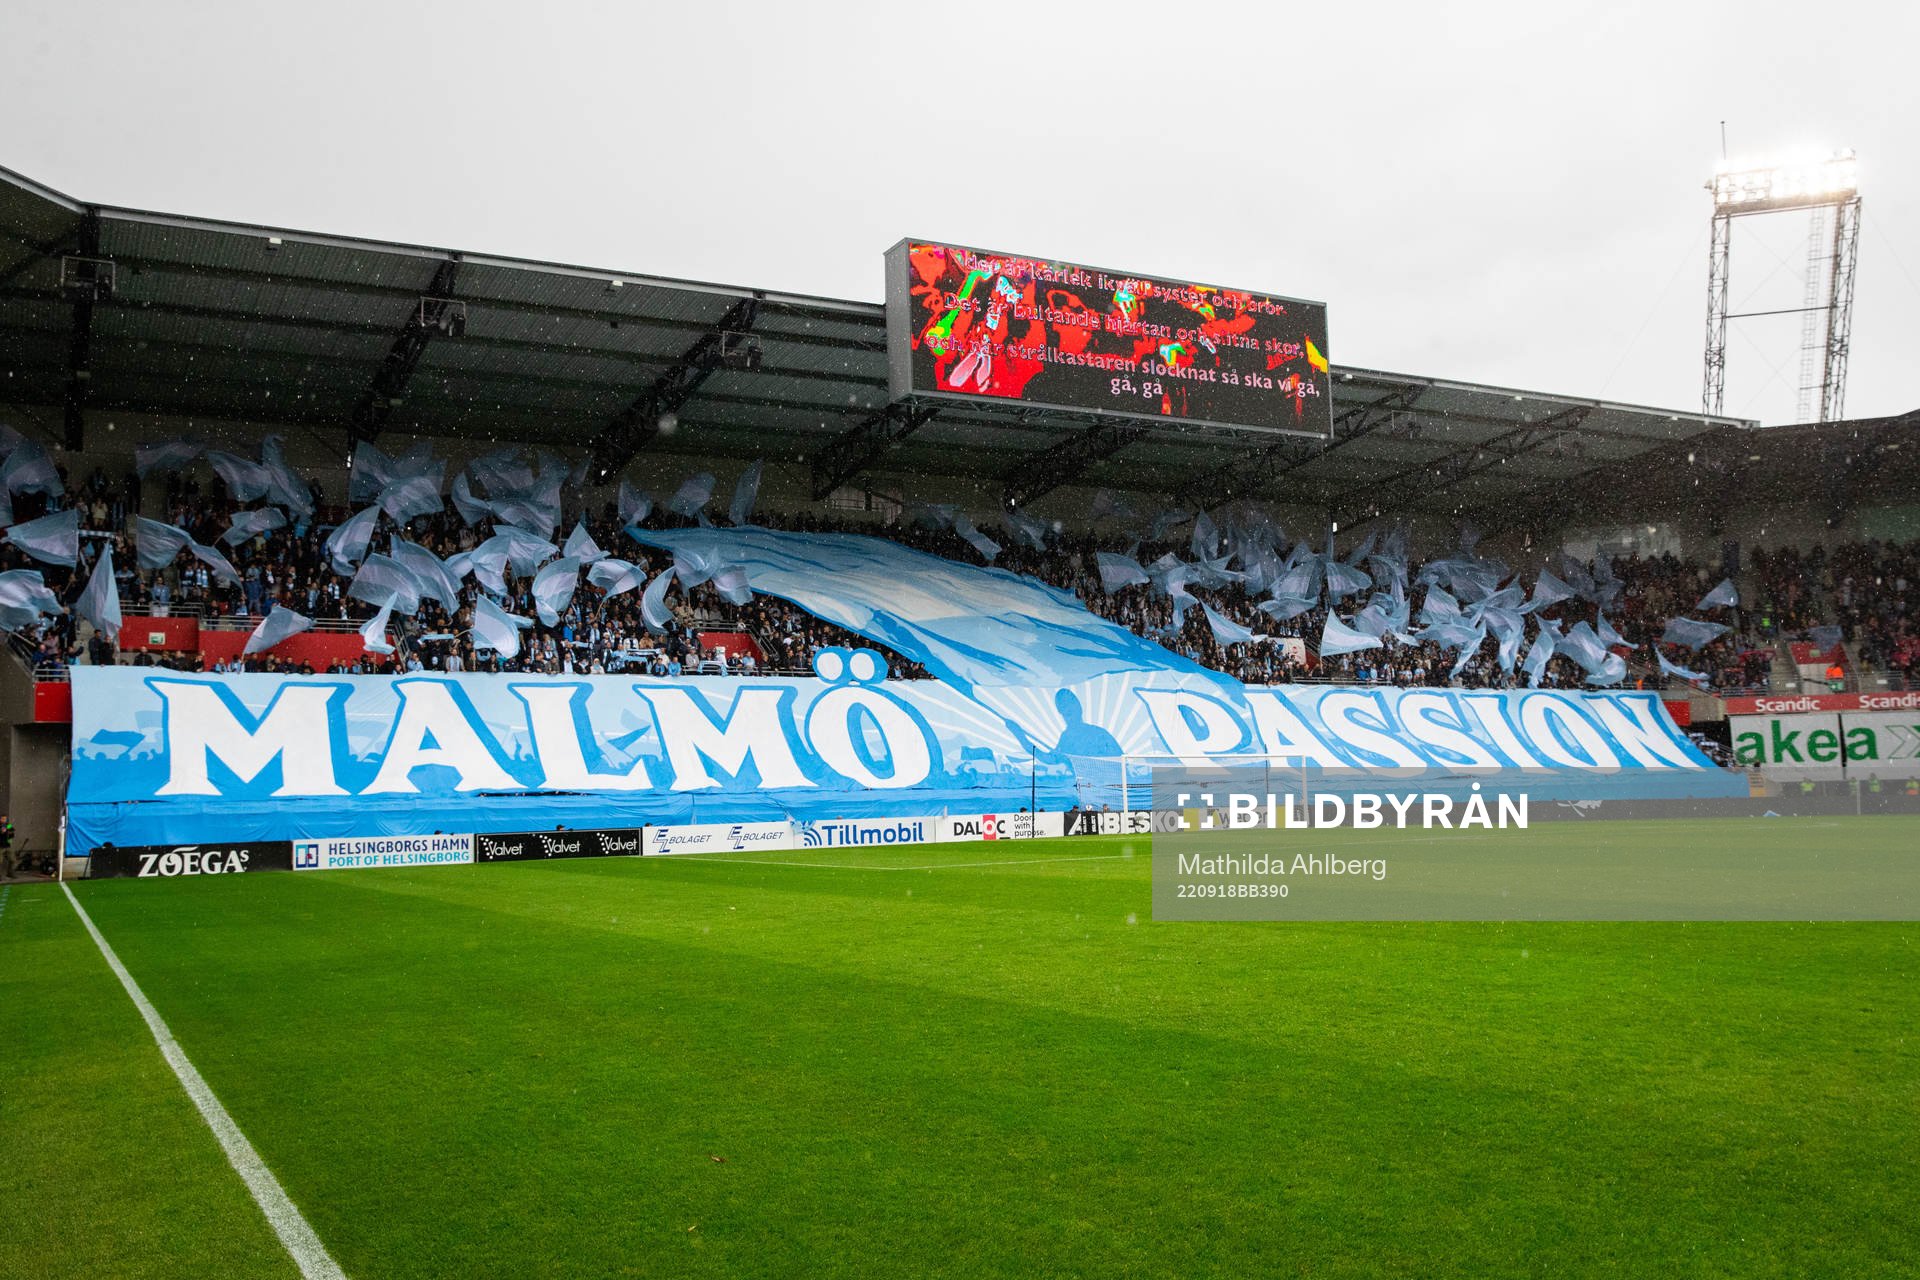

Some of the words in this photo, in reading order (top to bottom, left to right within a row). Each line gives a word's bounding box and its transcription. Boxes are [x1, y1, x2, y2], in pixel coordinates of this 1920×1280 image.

[1030, 262, 1092, 288] kärlek
[1153, 285, 1207, 304] syster
[1212, 294, 1243, 310] och
[944, 292, 981, 312] Det
[987, 297, 1008, 314] är
[1014, 303, 1100, 328] bultande
[1104, 315, 1171, 337] hjärtan
[1176, 325, 1204, 343] och
[926, 334, 963, 351] och
[1008, 343, 1136, 373] strålkastaren
[1142, 359, 1217, 382] slocknat
[1222, 368, 1239, 386] så
[1244, 372, 1273, 390] ska
[1277, 374, 1292, 392] vi
[1296, 378, 1320, 399] gå,
[1110, 374, 1137, 395] gå,
[1142, 377, 1163, 399] gå
[1755, 697, 1820, 712] Scandic
[150, 646, 936, 798] MALMÖ
[1137, 690, 1706, 774] PASSION
[1735, 720, 1880, 765] akea
[821, 822, 925, 846] Tillmobil
[953, 819, 1006, 836] DALOC
[1014, 822, 1031, 830] with
[329, 839, 428, 855] HELSINGBORGS
[432, 838, 469, 851] HAMN
[488, 841, 523, 856] Valvet
[547, 838, 581, 853] Valvet
[604, 836, 638, 851] Valvet
[329, 855, 362, 867] PORT
[363, 855, 380, 866] OF
[383, 851, 470, 865] HELSINGBORG
